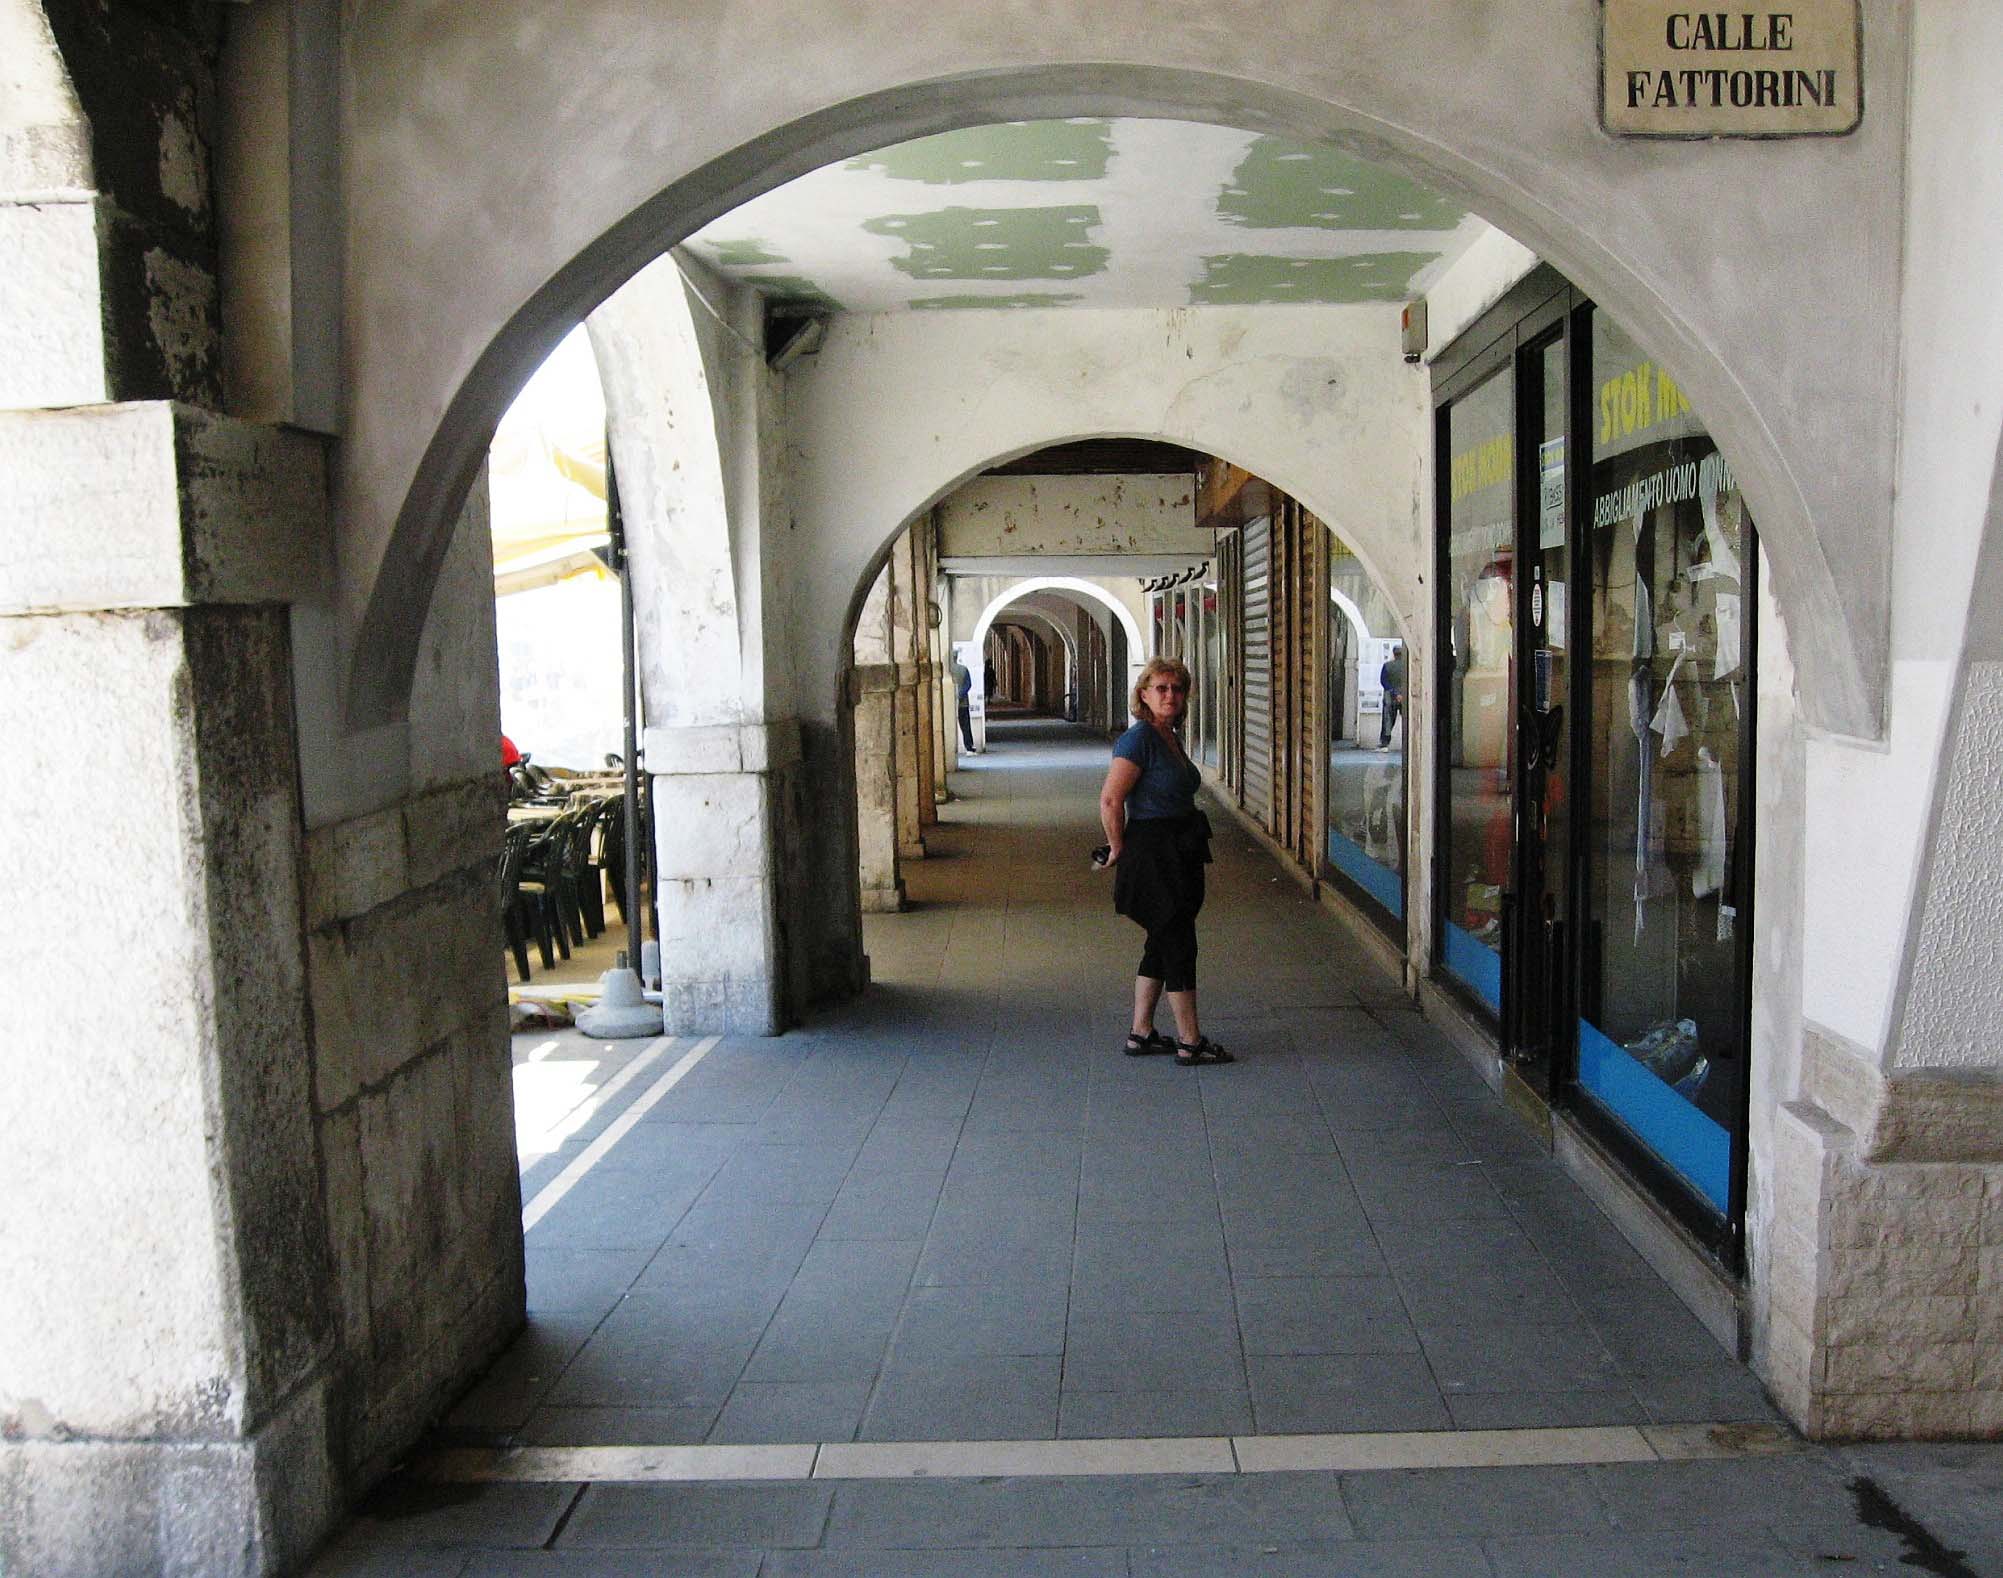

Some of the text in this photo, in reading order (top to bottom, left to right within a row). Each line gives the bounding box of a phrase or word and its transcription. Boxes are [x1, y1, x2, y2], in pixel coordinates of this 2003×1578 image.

[1666, 13, 1793, 51] CALLE
[1626, 69, 1836, 108] FATTORINI
[1600, 361, 1653, 445] STOK
[1593, 471, 1664, 530] ABBIGLIAMENTO
[1665, 461, 1697, 504] UOMO
